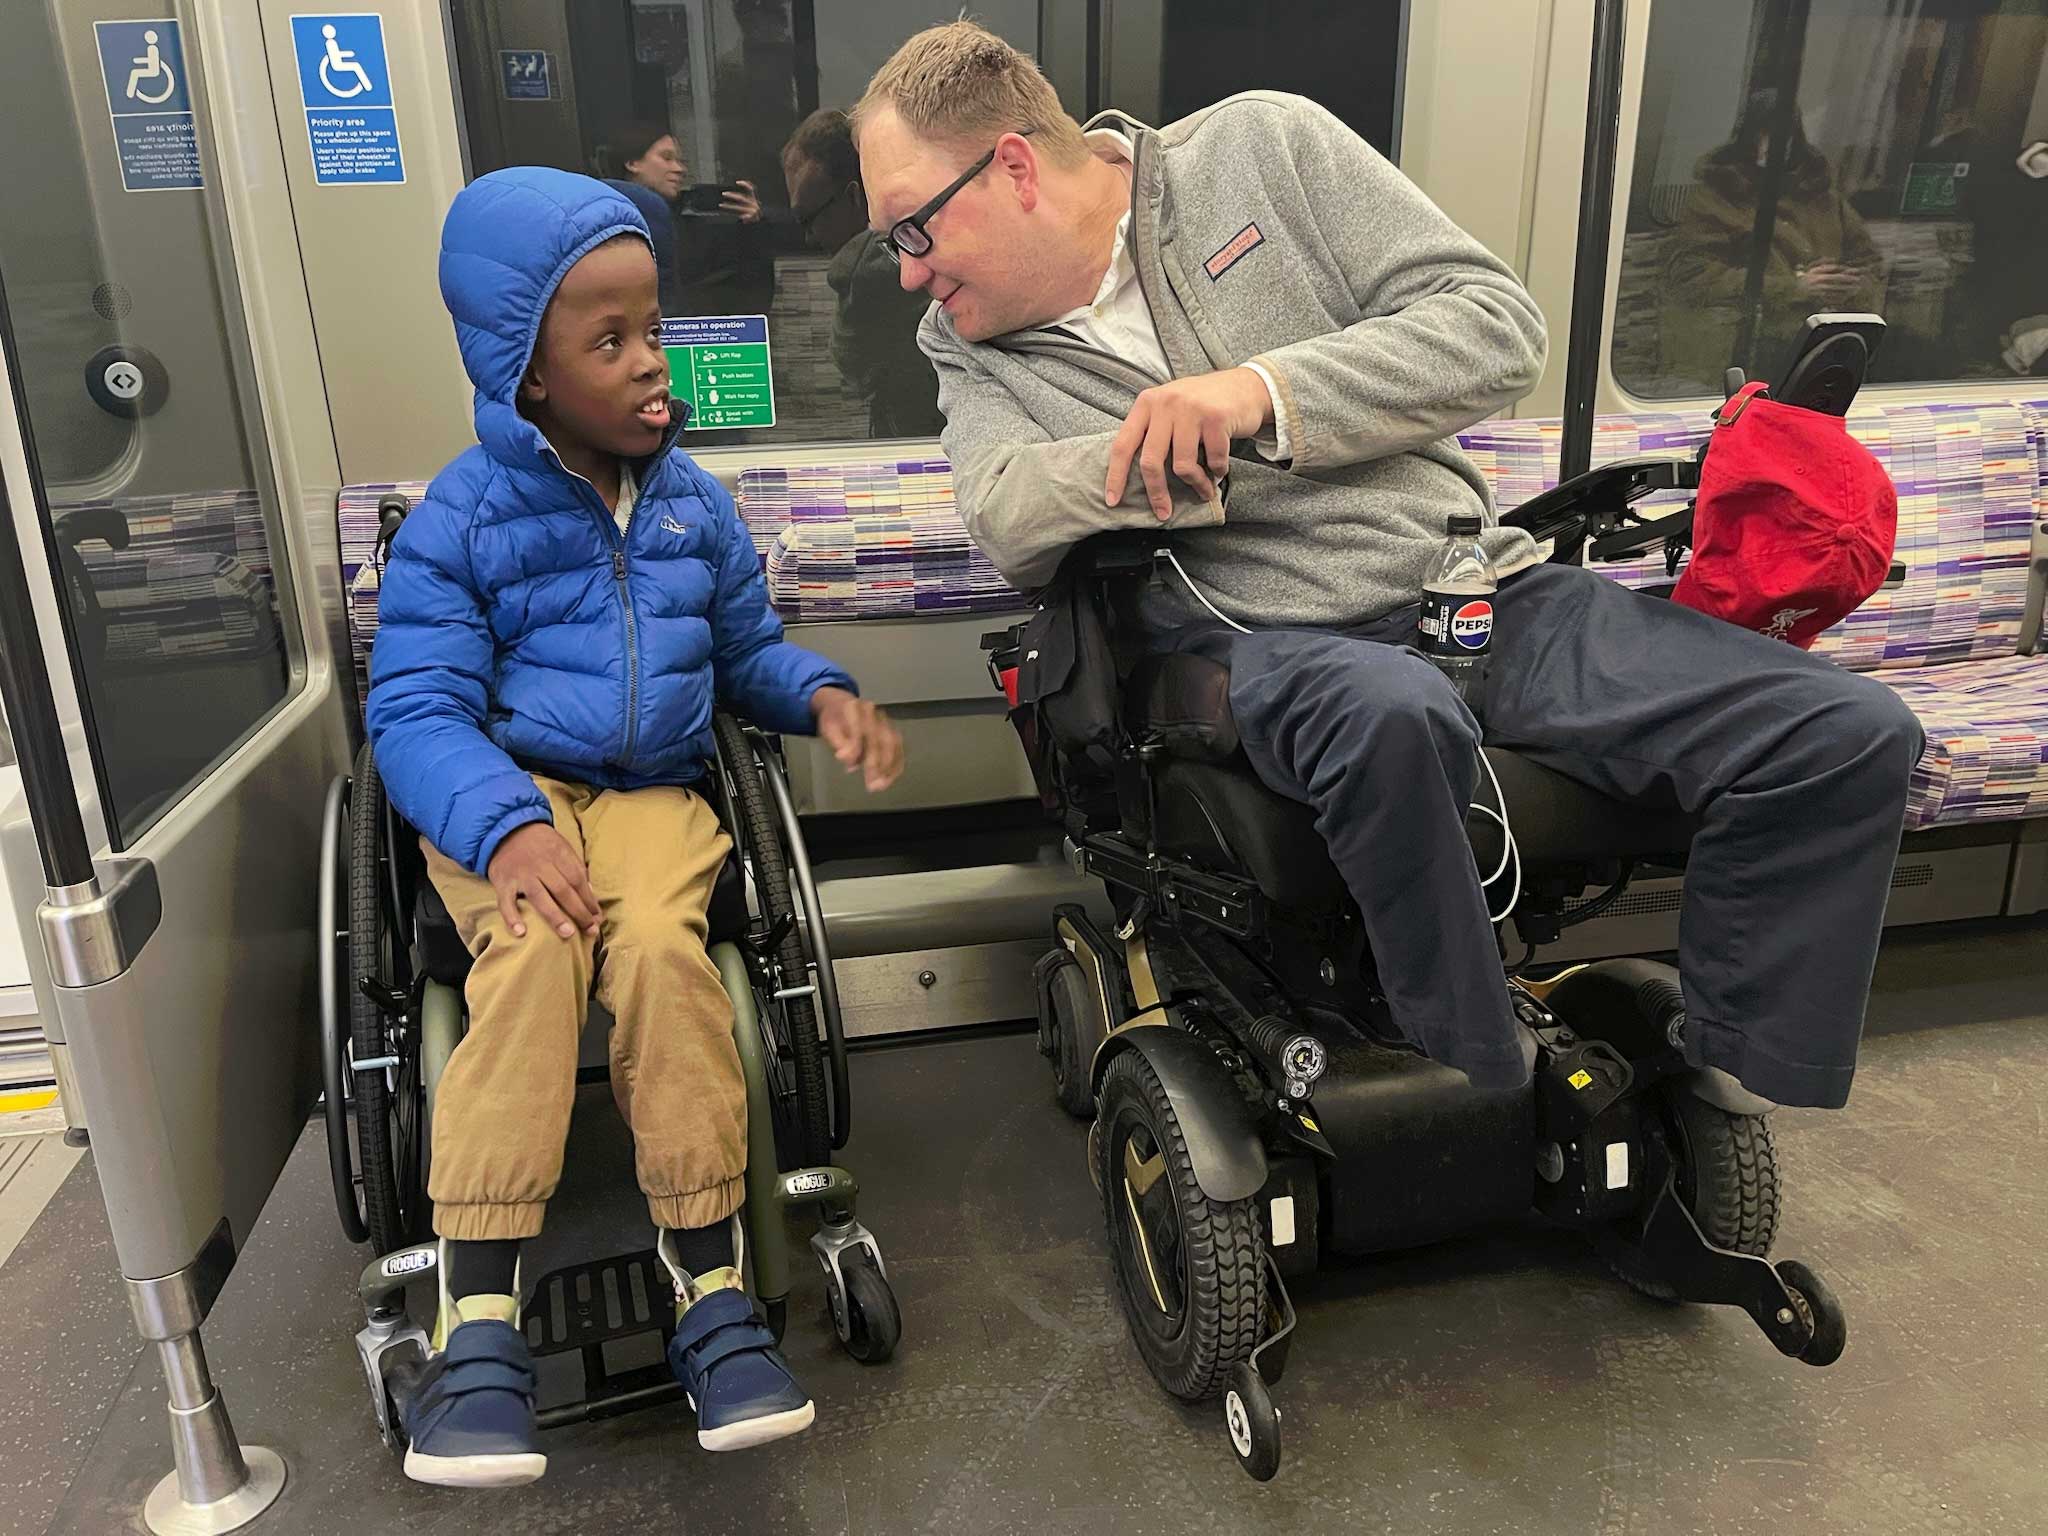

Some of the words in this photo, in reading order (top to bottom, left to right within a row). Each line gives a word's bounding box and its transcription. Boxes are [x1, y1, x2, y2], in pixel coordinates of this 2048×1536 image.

[311, 118, 344, 128] Priority
[668, 323, 700, 331] cameras
[709, 321, 746, 331] operation
[1442, 605, 1450, 631] SUGAR
[1441, 632, 1447, 643] NO
[795, 1174, 828, 1191] ROGUE
[389, 1253, 426, 1273] ROGUE
